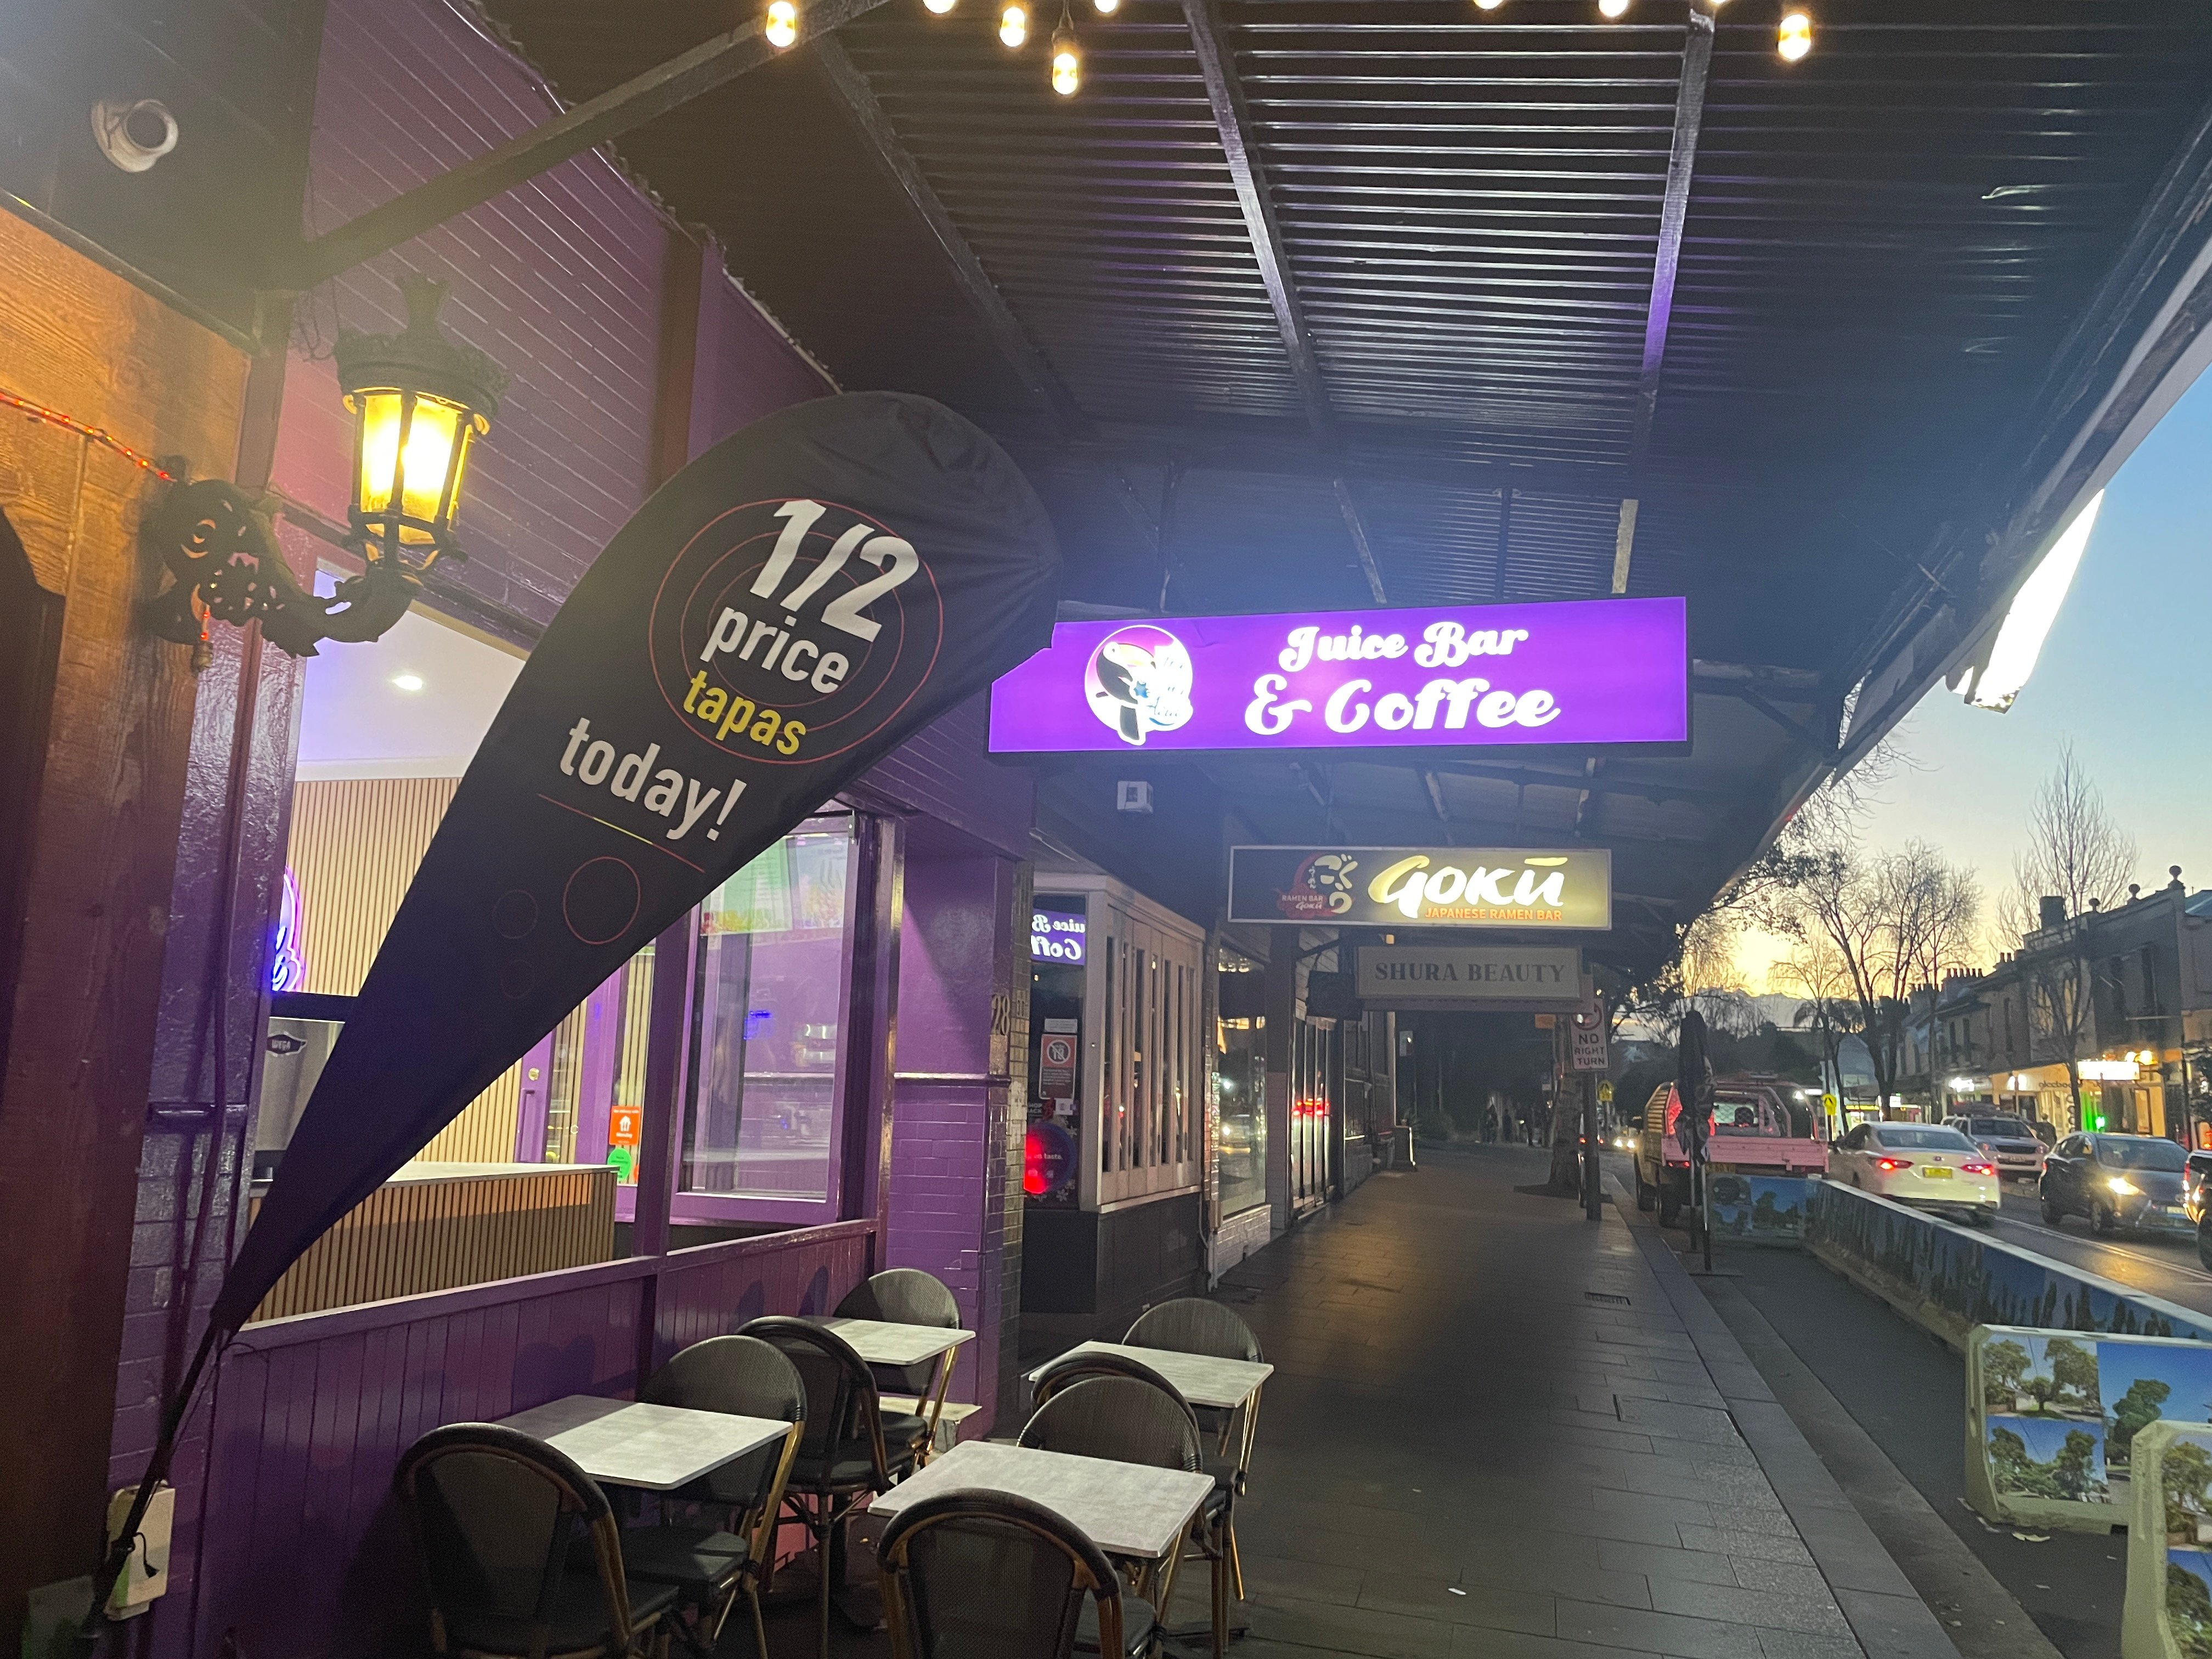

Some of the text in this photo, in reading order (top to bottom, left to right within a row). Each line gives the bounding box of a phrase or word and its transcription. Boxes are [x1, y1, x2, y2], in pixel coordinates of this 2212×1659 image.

[749, 499, 919, 642] 1/2
[699, 606, 849, 693] price
[1278, 621, 1528, 672] Juice Bar
[682, 670, 806, 755] tapas
[1244, 674, 1312, 736] &
[1324, 677, 1561, 734] Coffee
[558, 716, 747, 842] today!
[1425, 907, 1562, 921] JAPANESE RAMEN BAR
[1374, 962, 1565, 983] SHURA BEAUTY
[1575, 1046, 1605, 1055] RIGHT
[1577, 1057, 1605, 1065] TURN
[1579, 1033, 1599, 1045] NO
